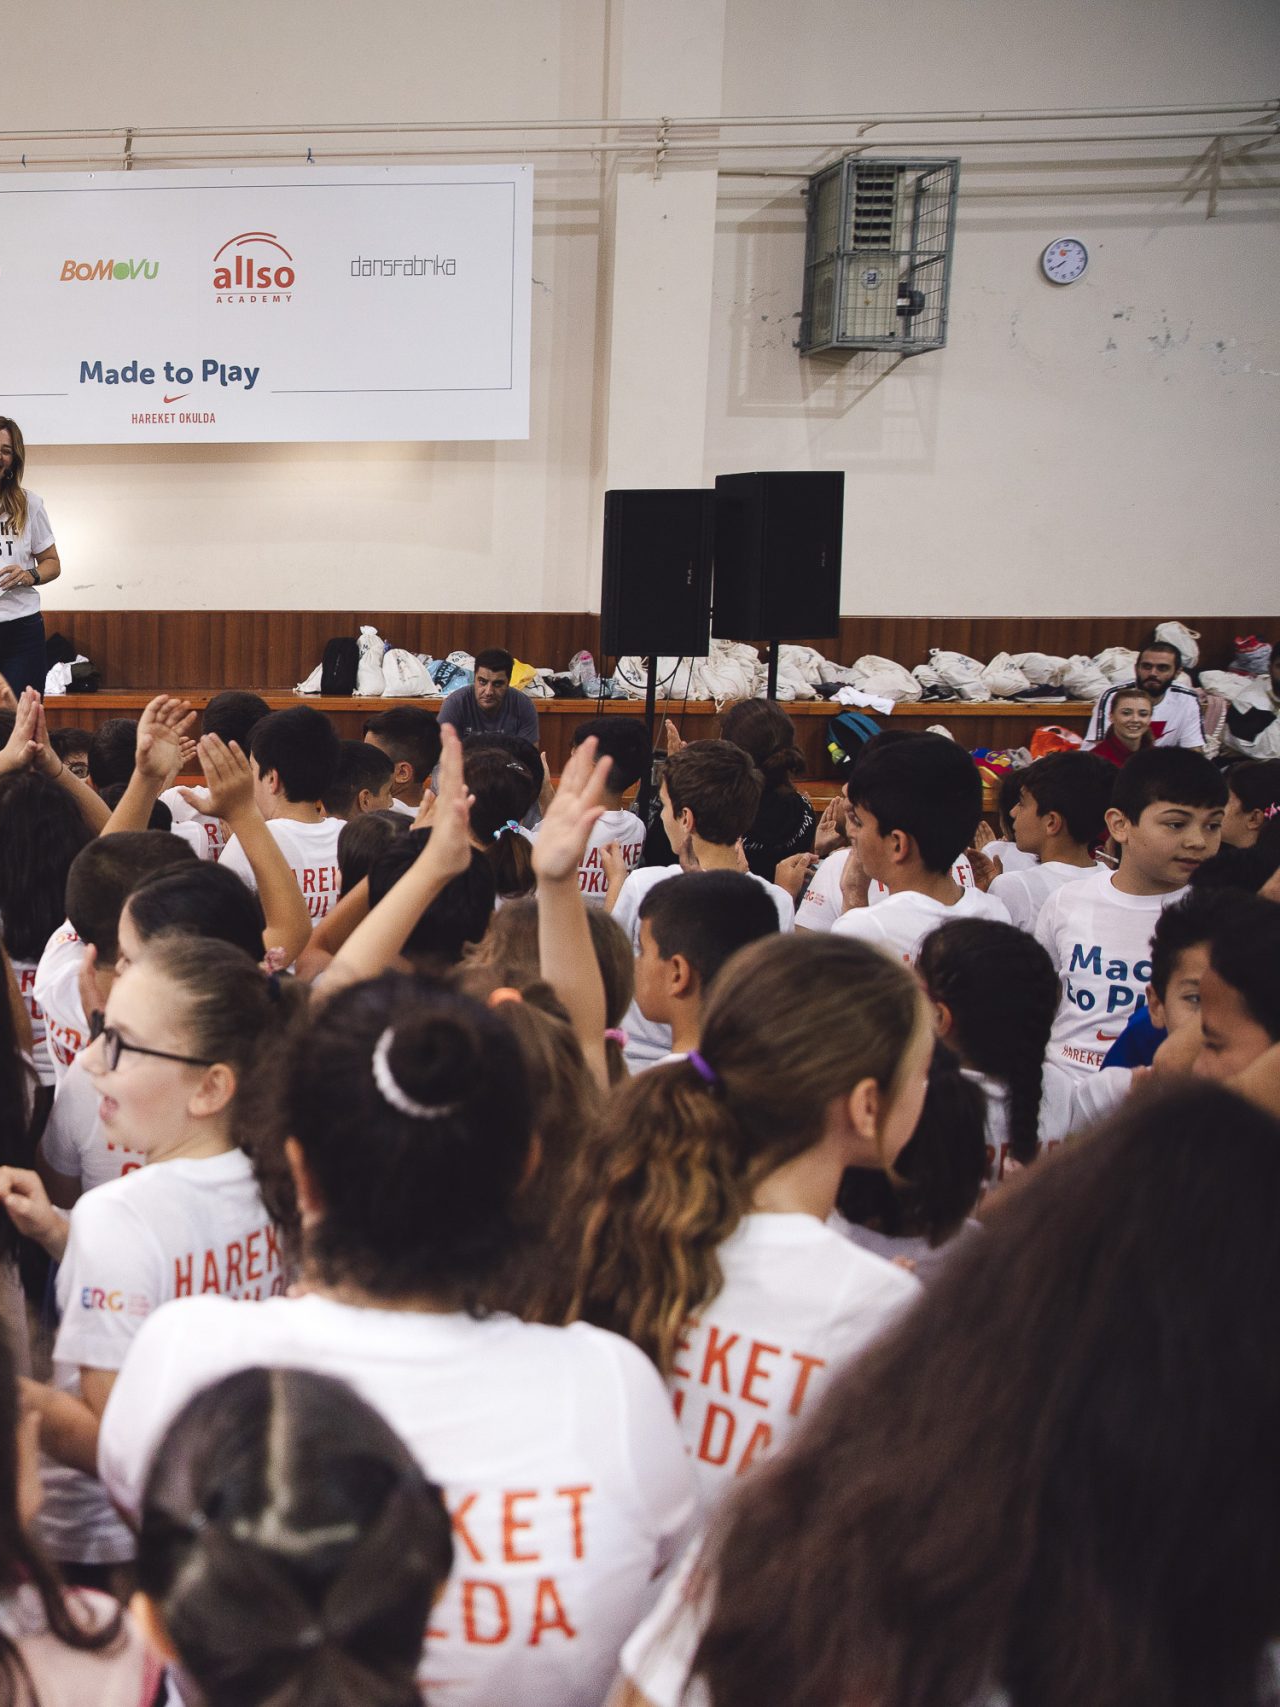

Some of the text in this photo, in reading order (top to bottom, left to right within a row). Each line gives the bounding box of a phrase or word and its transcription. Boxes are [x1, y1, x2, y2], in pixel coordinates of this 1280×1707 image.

[213, 255, 296, 289] allso
[216, 295, 293, 304] ACADEMY
[79, 359, 261, 390] Made to Play
[131, 412, 216, 424] HAREKET OKULDA
